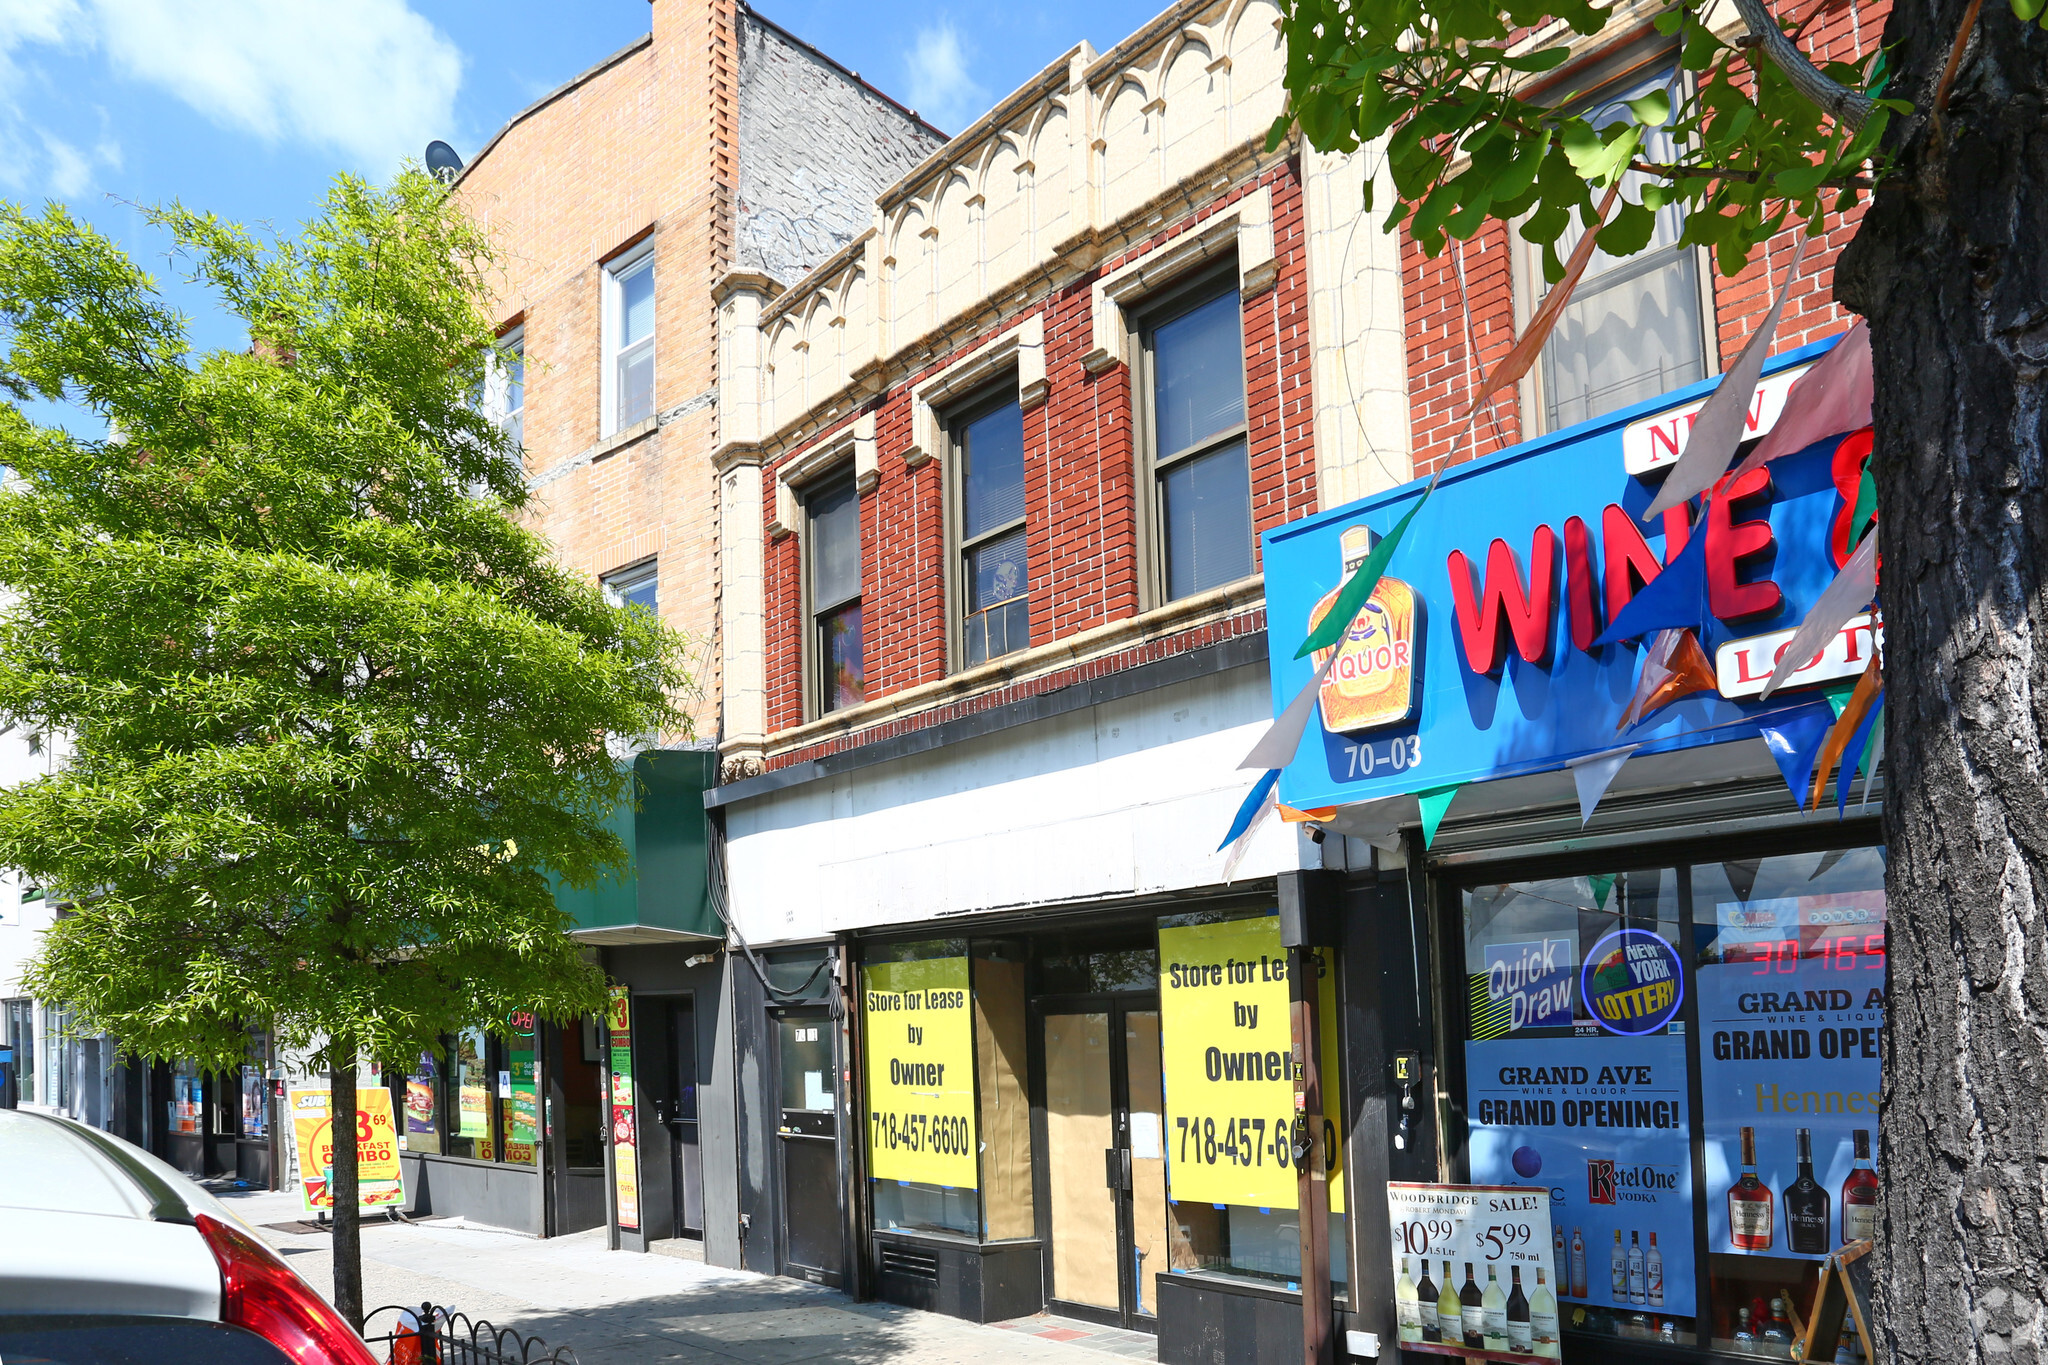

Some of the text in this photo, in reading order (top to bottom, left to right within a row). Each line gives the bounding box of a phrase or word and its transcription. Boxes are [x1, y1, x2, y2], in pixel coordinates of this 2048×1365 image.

[1447, 466, 1782, 675] WINE
[1319, 640, 1409, 686] LIQUOR
[1344, 734, 1421, 777] 70-03
[1625, 944, 1658, 961] NEW
[1752, 939, 1799, 975] 30
[1170, 962, 1222, 989] Store
[1226, 958, 1256, 985] for
[1488, 938, 1556, 1001] Quick
[1630, 958, 1671, 984] YORK
[868, 989, 963, 1012] Store for Lease
[1509, 976, 1573, 1032] Draw
[1595, 978, 1675, 1020] LOTTERY
[1738, 989, 1852, 1014] GRAND
[1233, 1001, 1259, 1029] by
[1767, 1015, 1806, 1023] WINE
[1837, 1013, 1885, 1021] LIQU
[908, 1024, 923, 1046] by
[1712, 1027, 1883, 1060] GRAND OPE
[890, 1058, 944, 1087] Owner
[1205, 1046, 1293, 1082] Owner
[1499, 1066, 1652, 1085] GRAND AVE
[1577, 1087, 1627, 1095] LIQUOR
[1755, 1083, 1880, 1114] Hennes
[1478, 1099, 1680, 1129] GRAND OPENING!
[872, 1112, 969, 1156] 718-457-6600
[1589, 1162, 1638, 1203] Ketel
[1642, 1166, 1678, 1190] One
[1389, 1191, 1538, 1213] WOODBRIDGE SALE!
[1406, 1206, 1430, 1214] ROBERT
[1432, 1207, 1467, 1216] MONDAVI
[1617, 1192, 1657, 1203] VODKA
[1790, 1212, 1825, 1225] Hennessy
[1429, 1246, 1456, 1256] 1.5 Ltr
[1509, 1251, 1540, 1261] 750 ml
